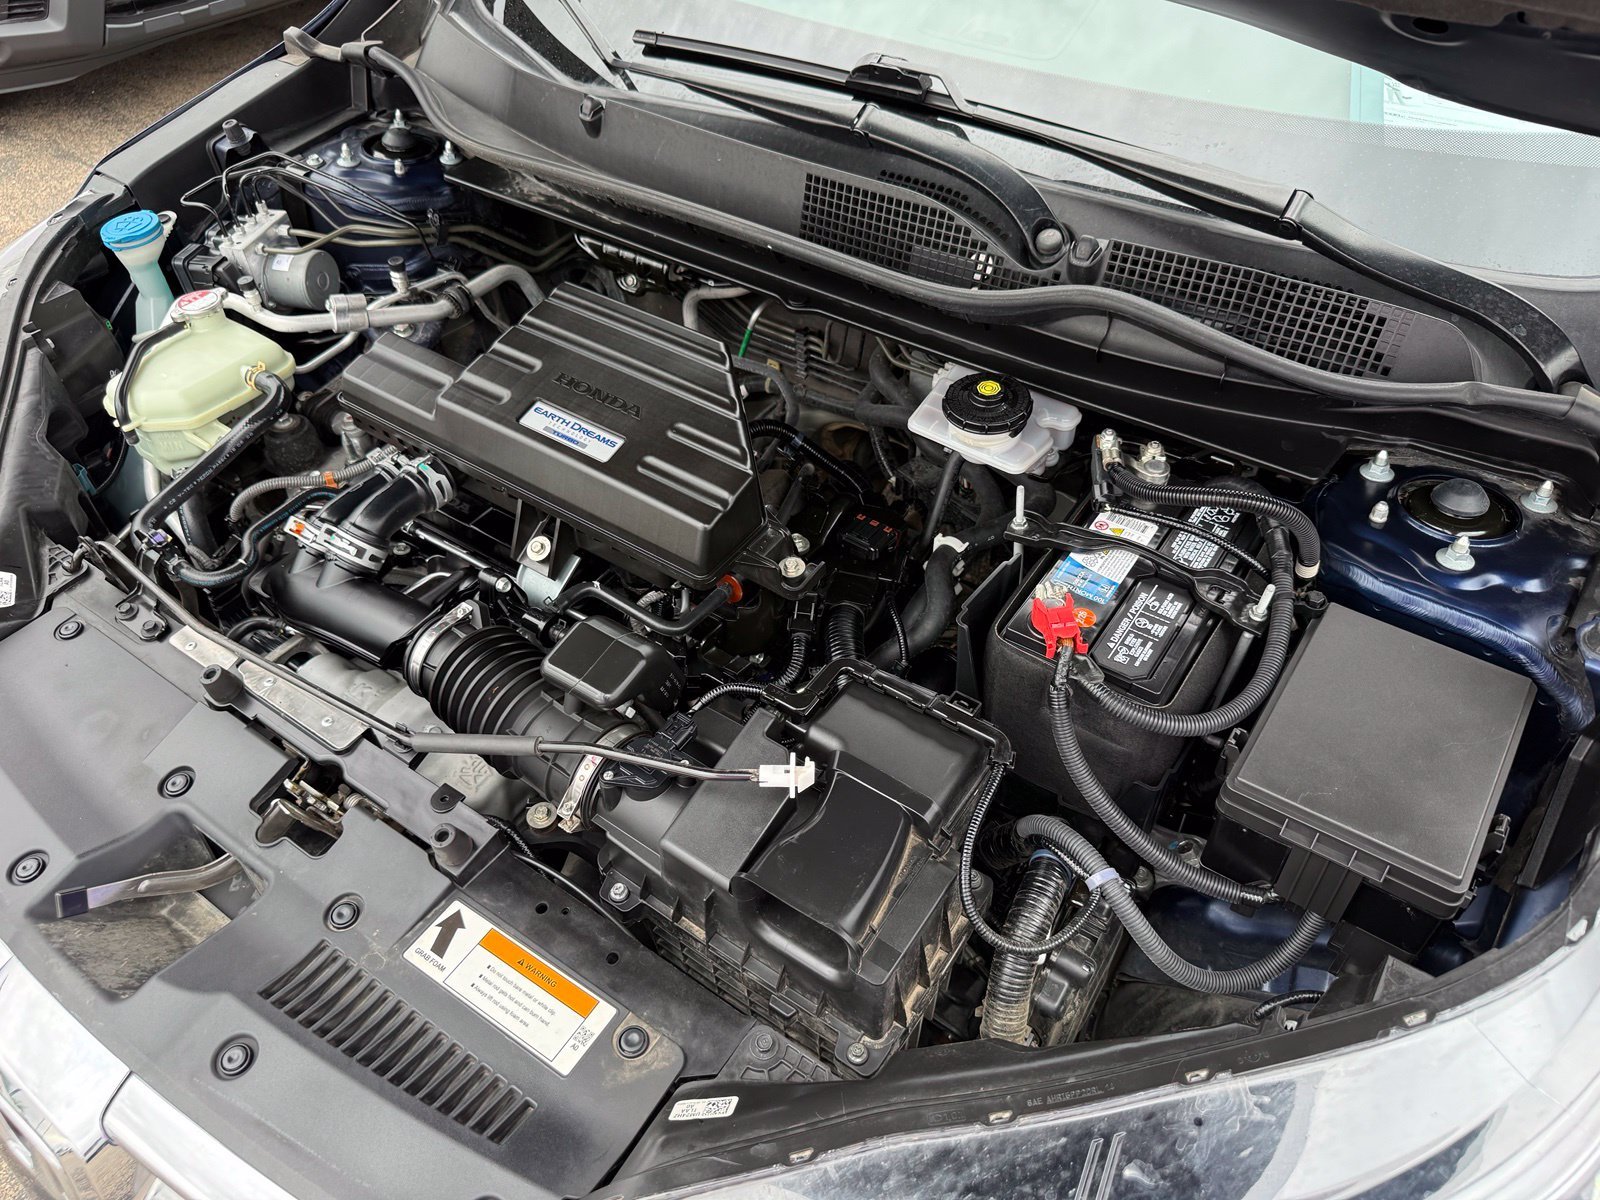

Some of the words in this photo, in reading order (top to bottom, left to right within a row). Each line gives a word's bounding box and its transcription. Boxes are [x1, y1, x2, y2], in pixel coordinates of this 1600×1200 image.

[552, 372, 642, 420] HONDA
[533, 406, 570, 427] EARTH
[571, 422, 618, 448] DREAMS
[551, 430, 580, 446] TURBO
[1113, 617, 1131, 641] DANGER
[1131, 592, 1149, 613] POISON
[414, 947, 431, 965] GRAB
[429, 957, 447, 974] FOAM
[501, 975, 514, 985] touch
[521, 989, 533, 999] metal
[524, 962, 557, 988] WARNING
[472, 985, 488, 998] Always
